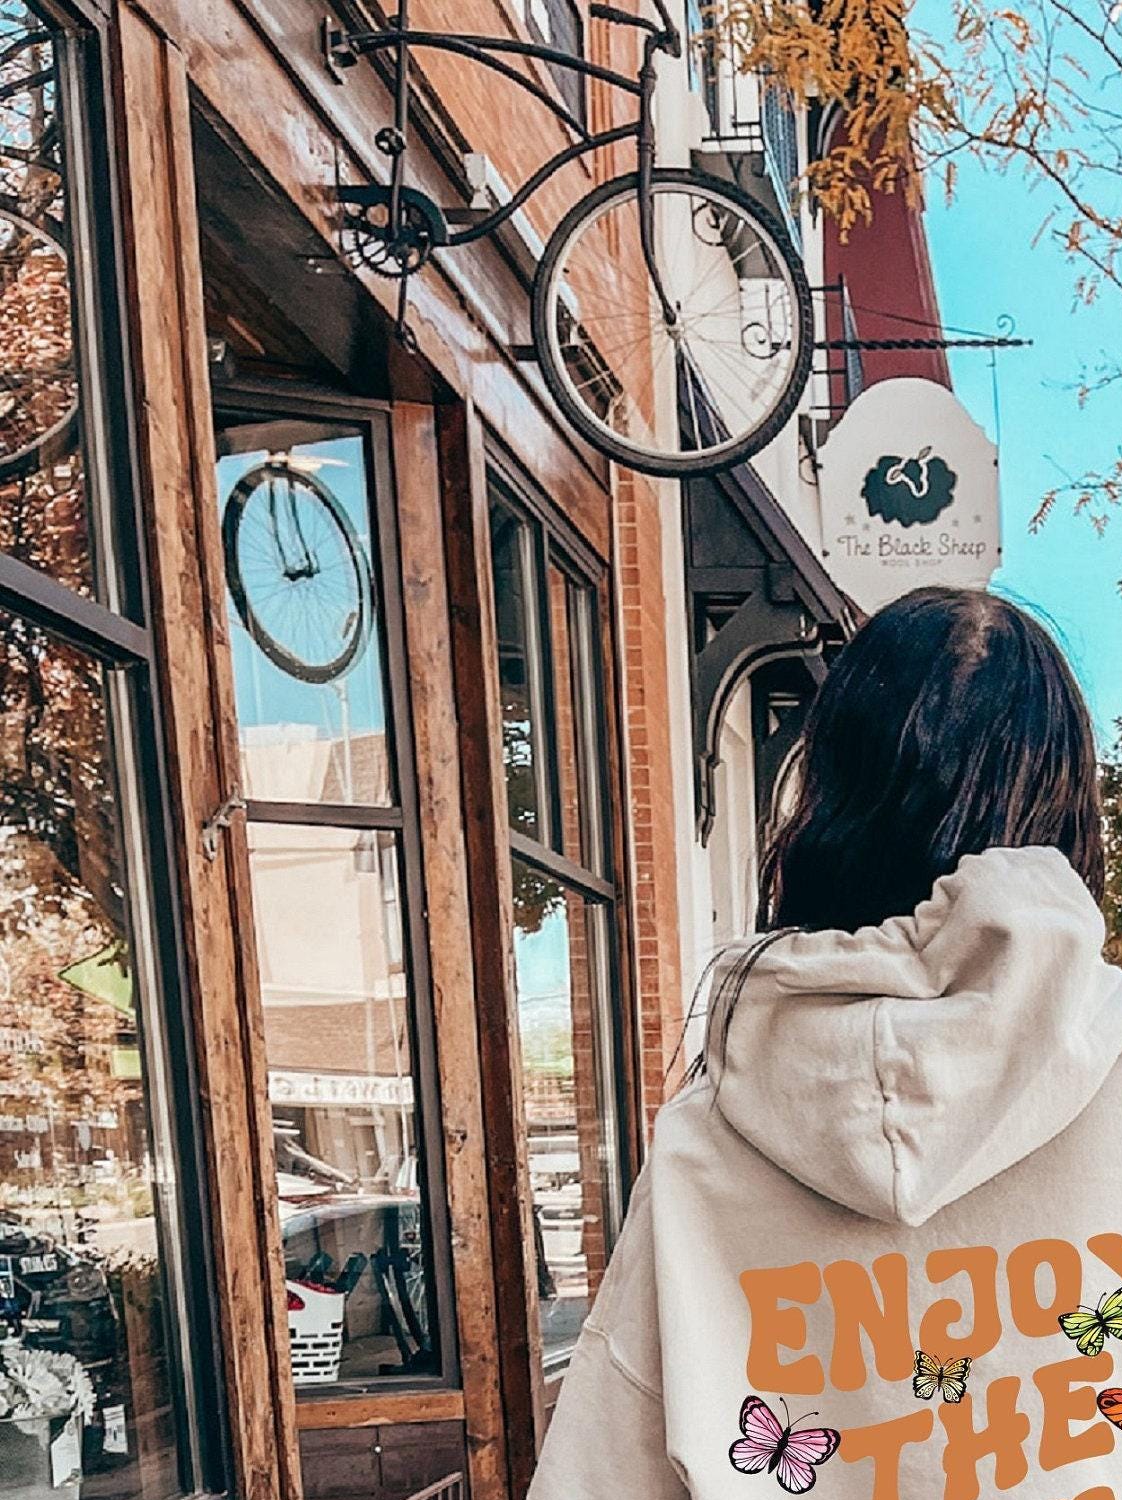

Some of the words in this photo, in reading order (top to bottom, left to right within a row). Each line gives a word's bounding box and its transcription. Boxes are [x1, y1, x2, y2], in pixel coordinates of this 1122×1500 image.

[837, 534, 871, 556] The
[878, 533, 932, 557] Black
[939, 532, 987, 560] Sheep
